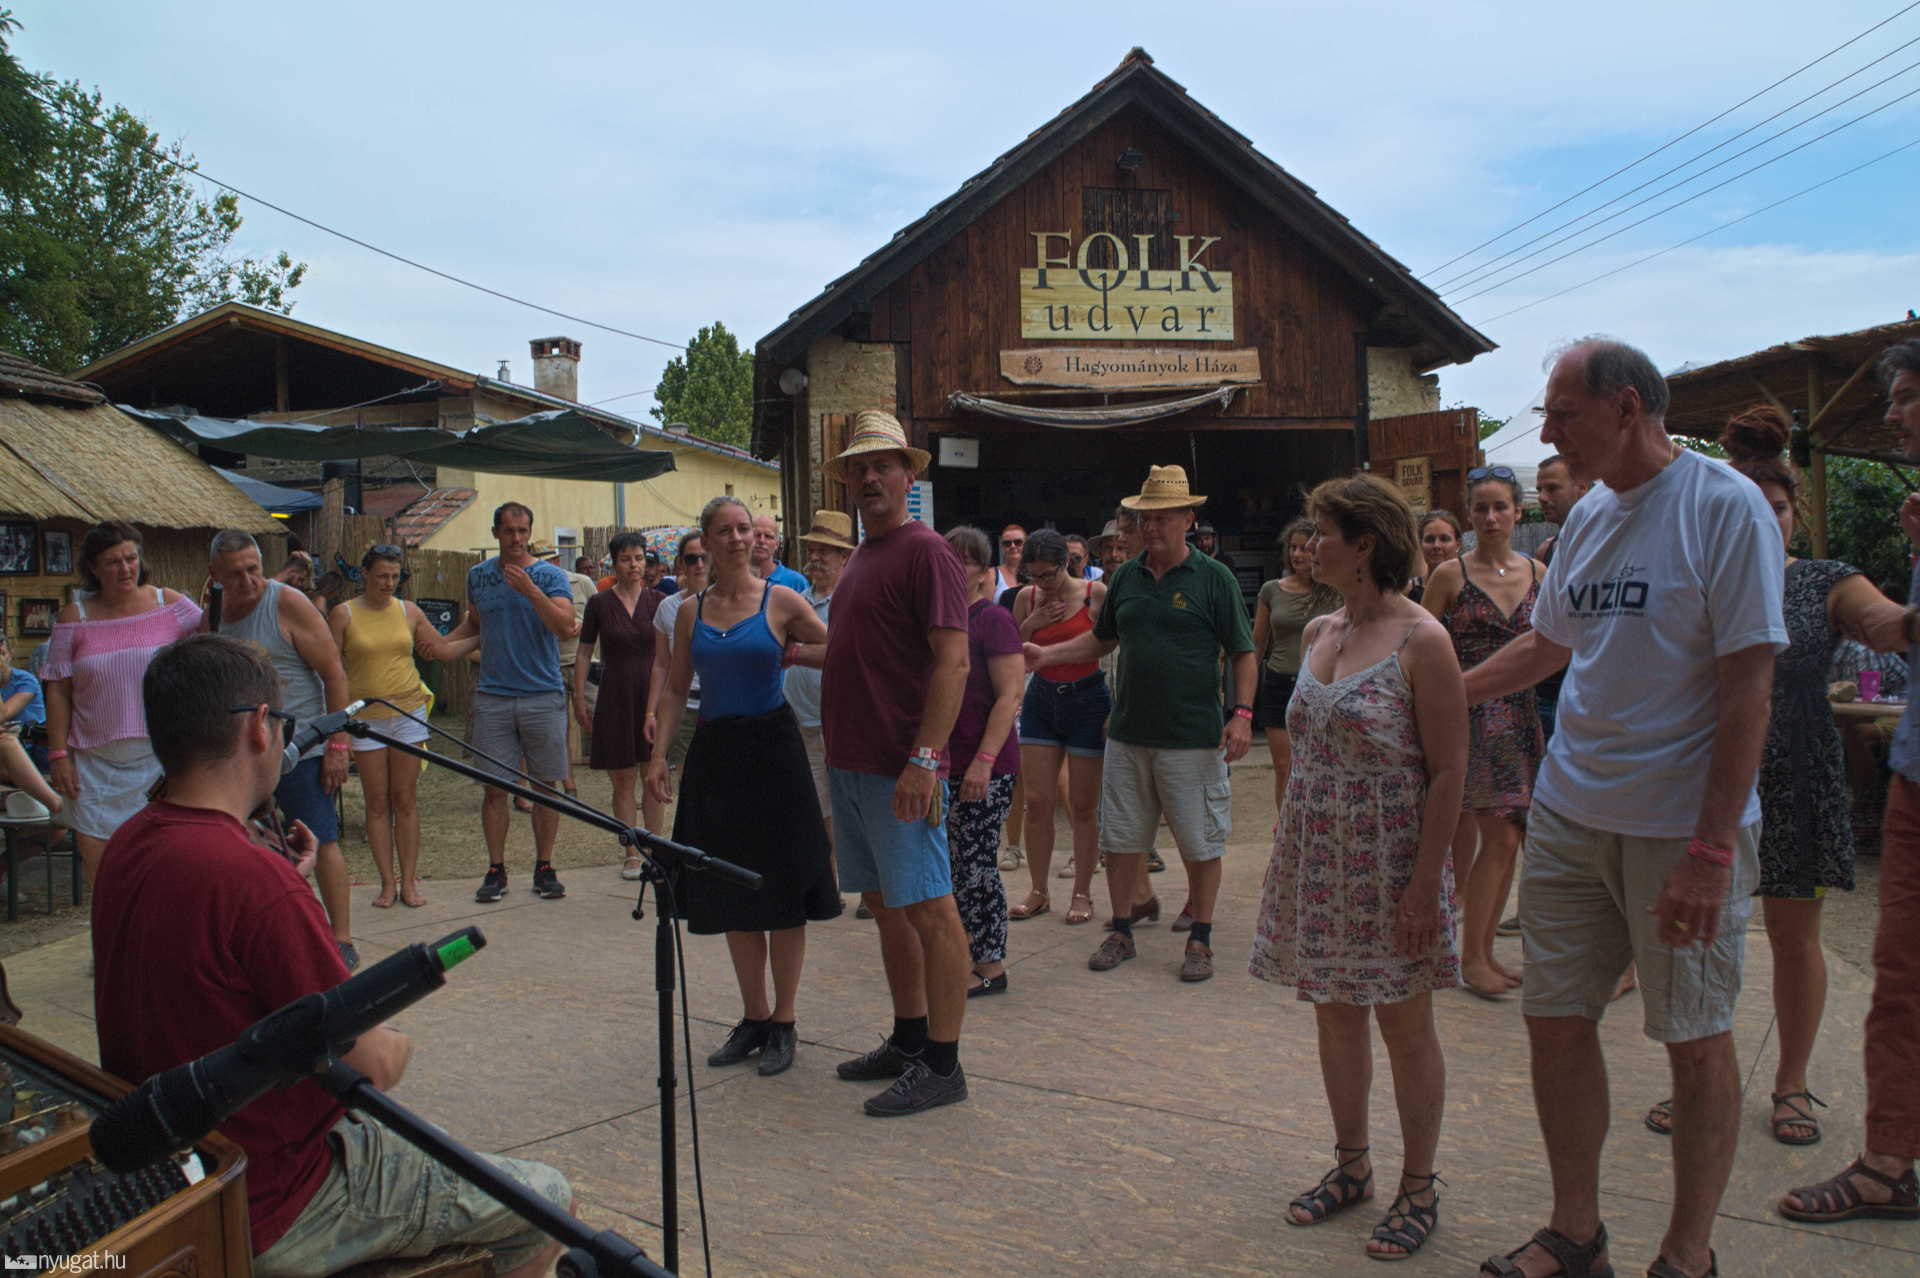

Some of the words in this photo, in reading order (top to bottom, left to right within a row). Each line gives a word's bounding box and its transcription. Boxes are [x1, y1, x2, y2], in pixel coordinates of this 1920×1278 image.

[1030, 229, 1222, 295] FOLK
[1043, 272, 1215, 334] udvar
[1064, 354, 1189, 377] Hagyományok
[1195, 354, 1239, 374] Háza
[1402, 463, 1423, 477] FOLK
[1567, 581, 1649, 611] VIZIO
